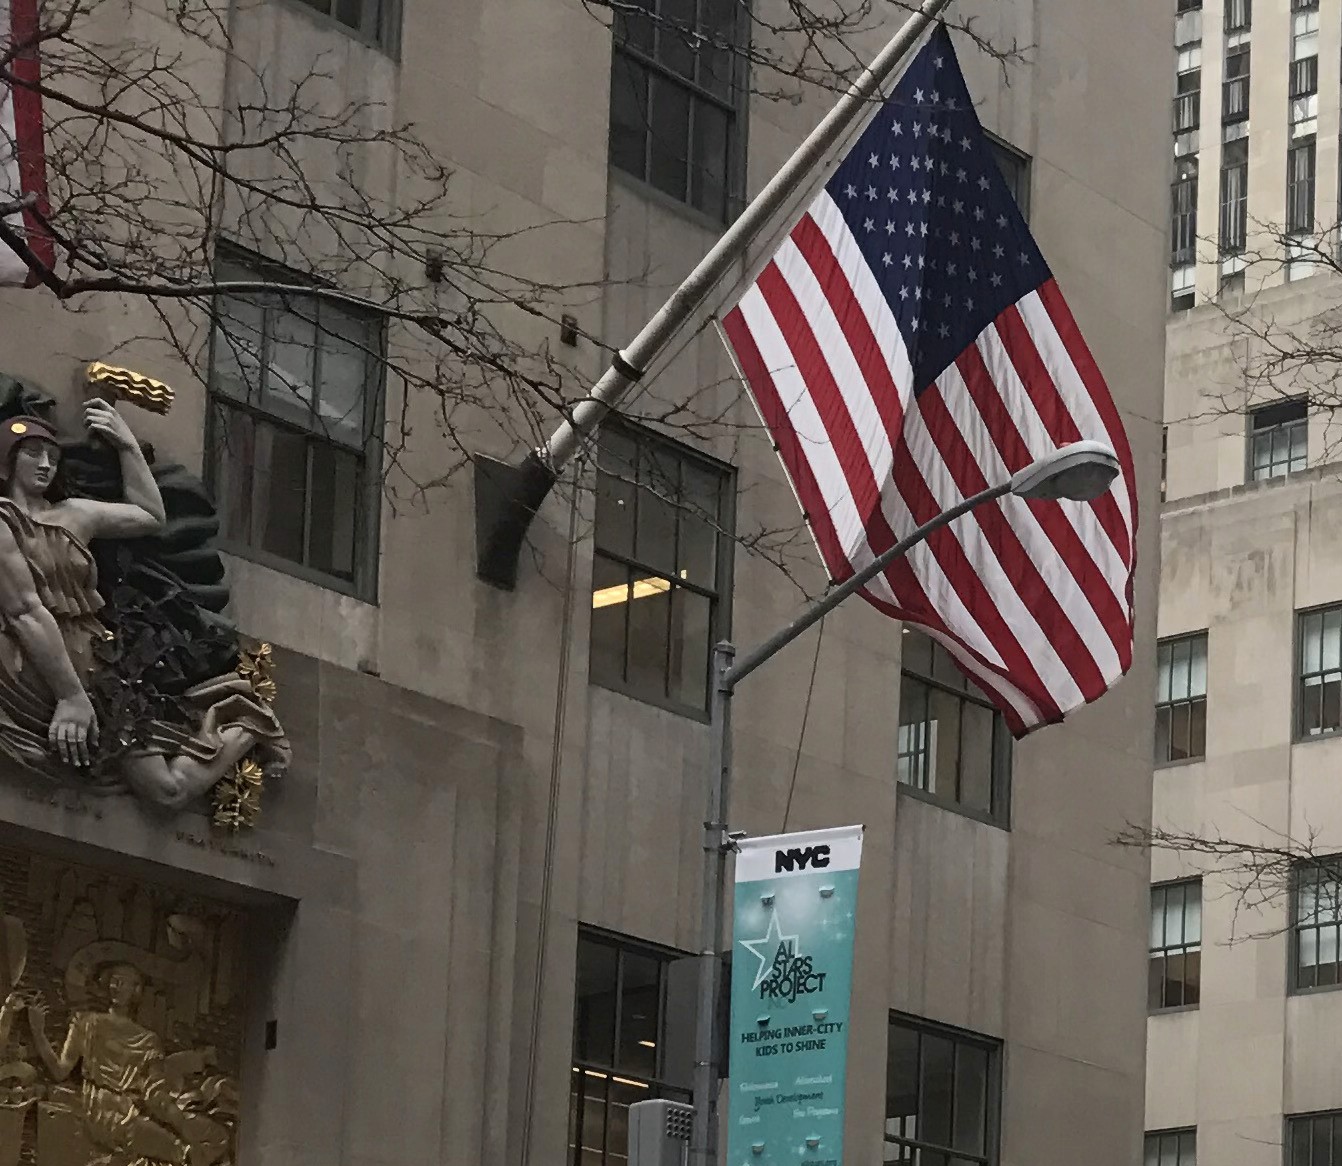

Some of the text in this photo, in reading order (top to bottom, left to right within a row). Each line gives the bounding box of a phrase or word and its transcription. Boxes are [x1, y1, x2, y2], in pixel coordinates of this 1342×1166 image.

[775, 845, 831, 873] NYC
[772, 955, 813, 980] STARS
[760, 972, 826, 1003] PROJECT
[741, 1022, 843, 1043] HELPING INNER-CITY
[755, 1039, 826, 1057] KIDS TO SHINE
